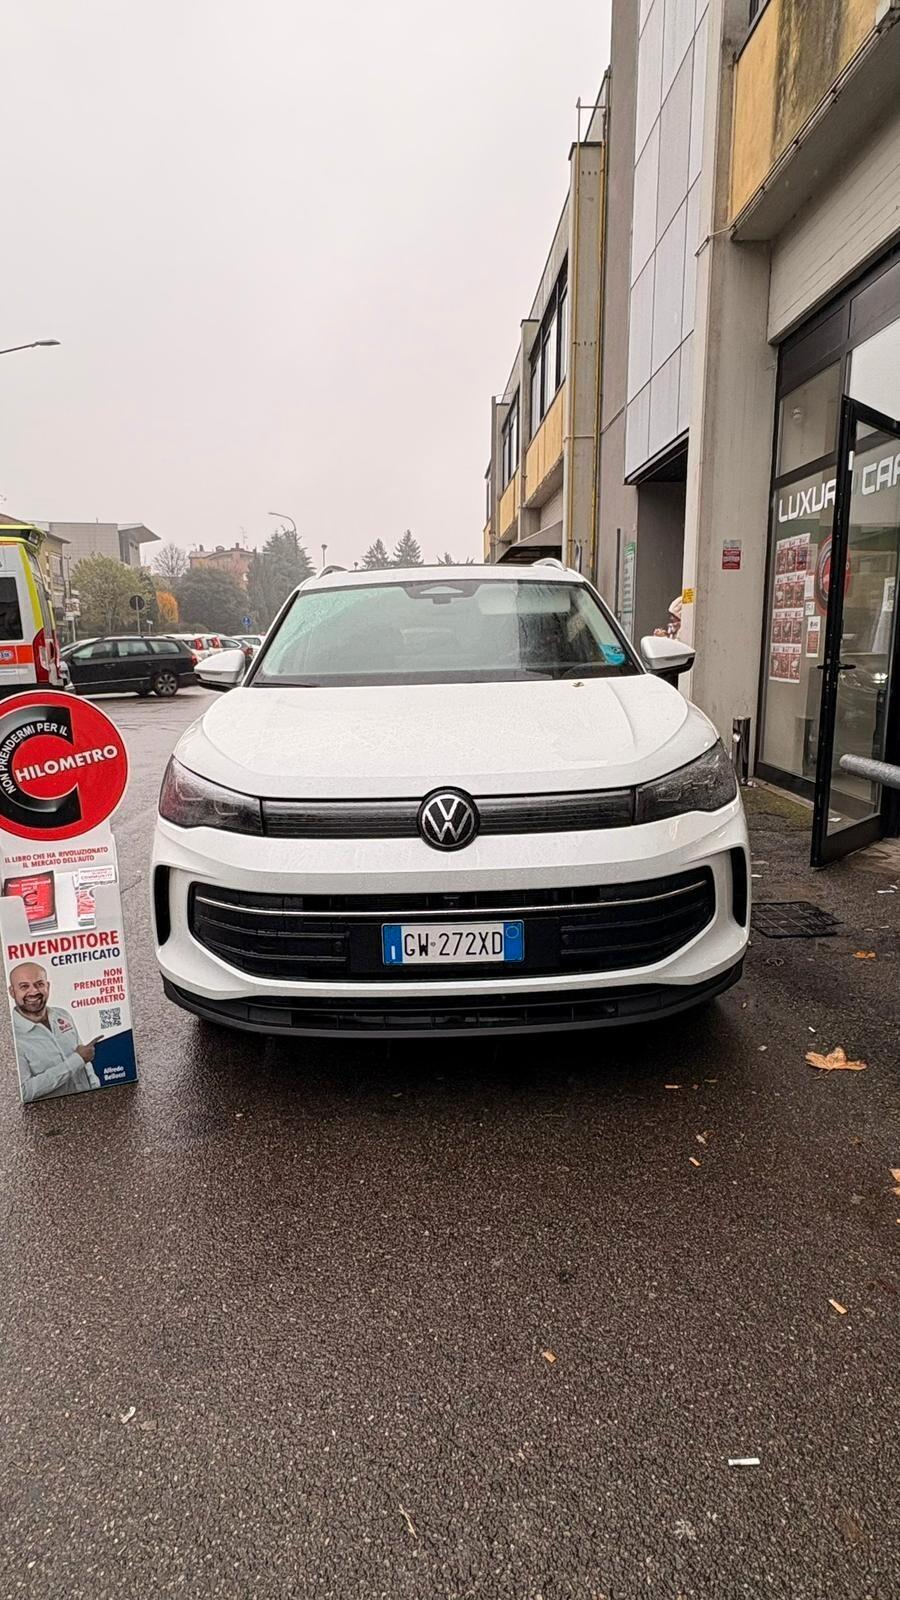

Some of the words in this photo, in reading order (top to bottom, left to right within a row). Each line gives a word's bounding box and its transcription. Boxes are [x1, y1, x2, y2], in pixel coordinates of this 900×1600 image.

[779, 478, 836, 523] LUXUR
[37, 722, 58, 733] PER
[59, 726, 69, 737] IL
[0, 726, 36, 772] PRENDERMI
[15, 745, 118, 783] HILOMETRO
[0, 773, 17, 795] NON
[11, 855, 32, 863] LIBRO
[33, 854, 45, 862] CHE
[58, 846, 109, 858] RIVOLUZIONATO
[31, 858, 61, 868] MERCATO
[7, 930, 120, 960] RIVENDITORE
[404, 933, 430, 957] GW
[439, 931, 503, 956] 272XD
[51, 947, 121, 967] CERTIFICATO
[103, 967, 123, 977] NON
[73, 976, 124, 991] PRENDERMI
[100, 987, 116, 995] PER
[117, 984, 125, 992] IL
[71, 993, 126, 1009] CHILOMETRO
